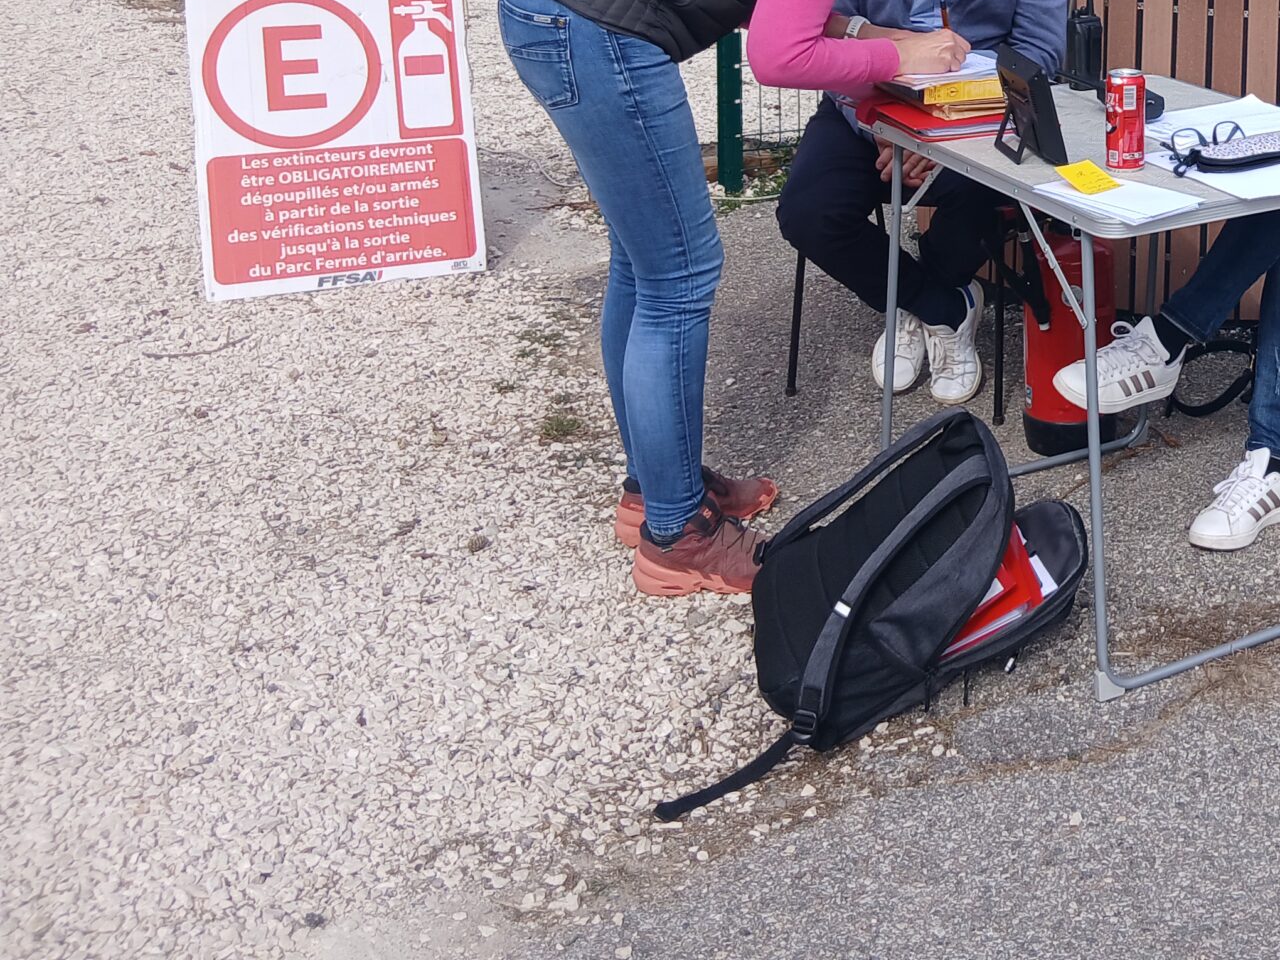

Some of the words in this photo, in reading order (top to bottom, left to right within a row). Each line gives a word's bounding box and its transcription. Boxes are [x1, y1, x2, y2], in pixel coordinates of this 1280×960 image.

[262, 24, 328, 112] E
[241, 157, 270, 170] Les
[272, 150, 366, 167] extincteurs
[369, 143, 434, 159] devront
[240, 174, 275, 188] être
[278, 158, 437, 184] OBLIGATOIREMENT
[240, 185, 340, 207] dégoupillés
[342, 182, 387, 197] et/ou
[390, 175, 440, 193] armés
[264, 208, 275, 222] à
[278, 203, 327, 223] partir
[329, 201, 352, 216] de
[354, 199, 369, 213] la
[372, 195, 420, 212] sortie
[227, 228, 258, 244] des
[260, 220, 365, 240] vérifications
[367, 210, 457, 230] techniques
[279, 237, 341, 260] jusqu'à
[344, 236, 360, 249] la
[363, 231, 411, 248] sortie
[248, 263, 272, 278] du
[275, 261, 313, 275] Parc
[315, 252, 368, 271] Fermé
[370, 245, 448, 264] d'arrivée.
[317, 271, 378, 288] FFSA
